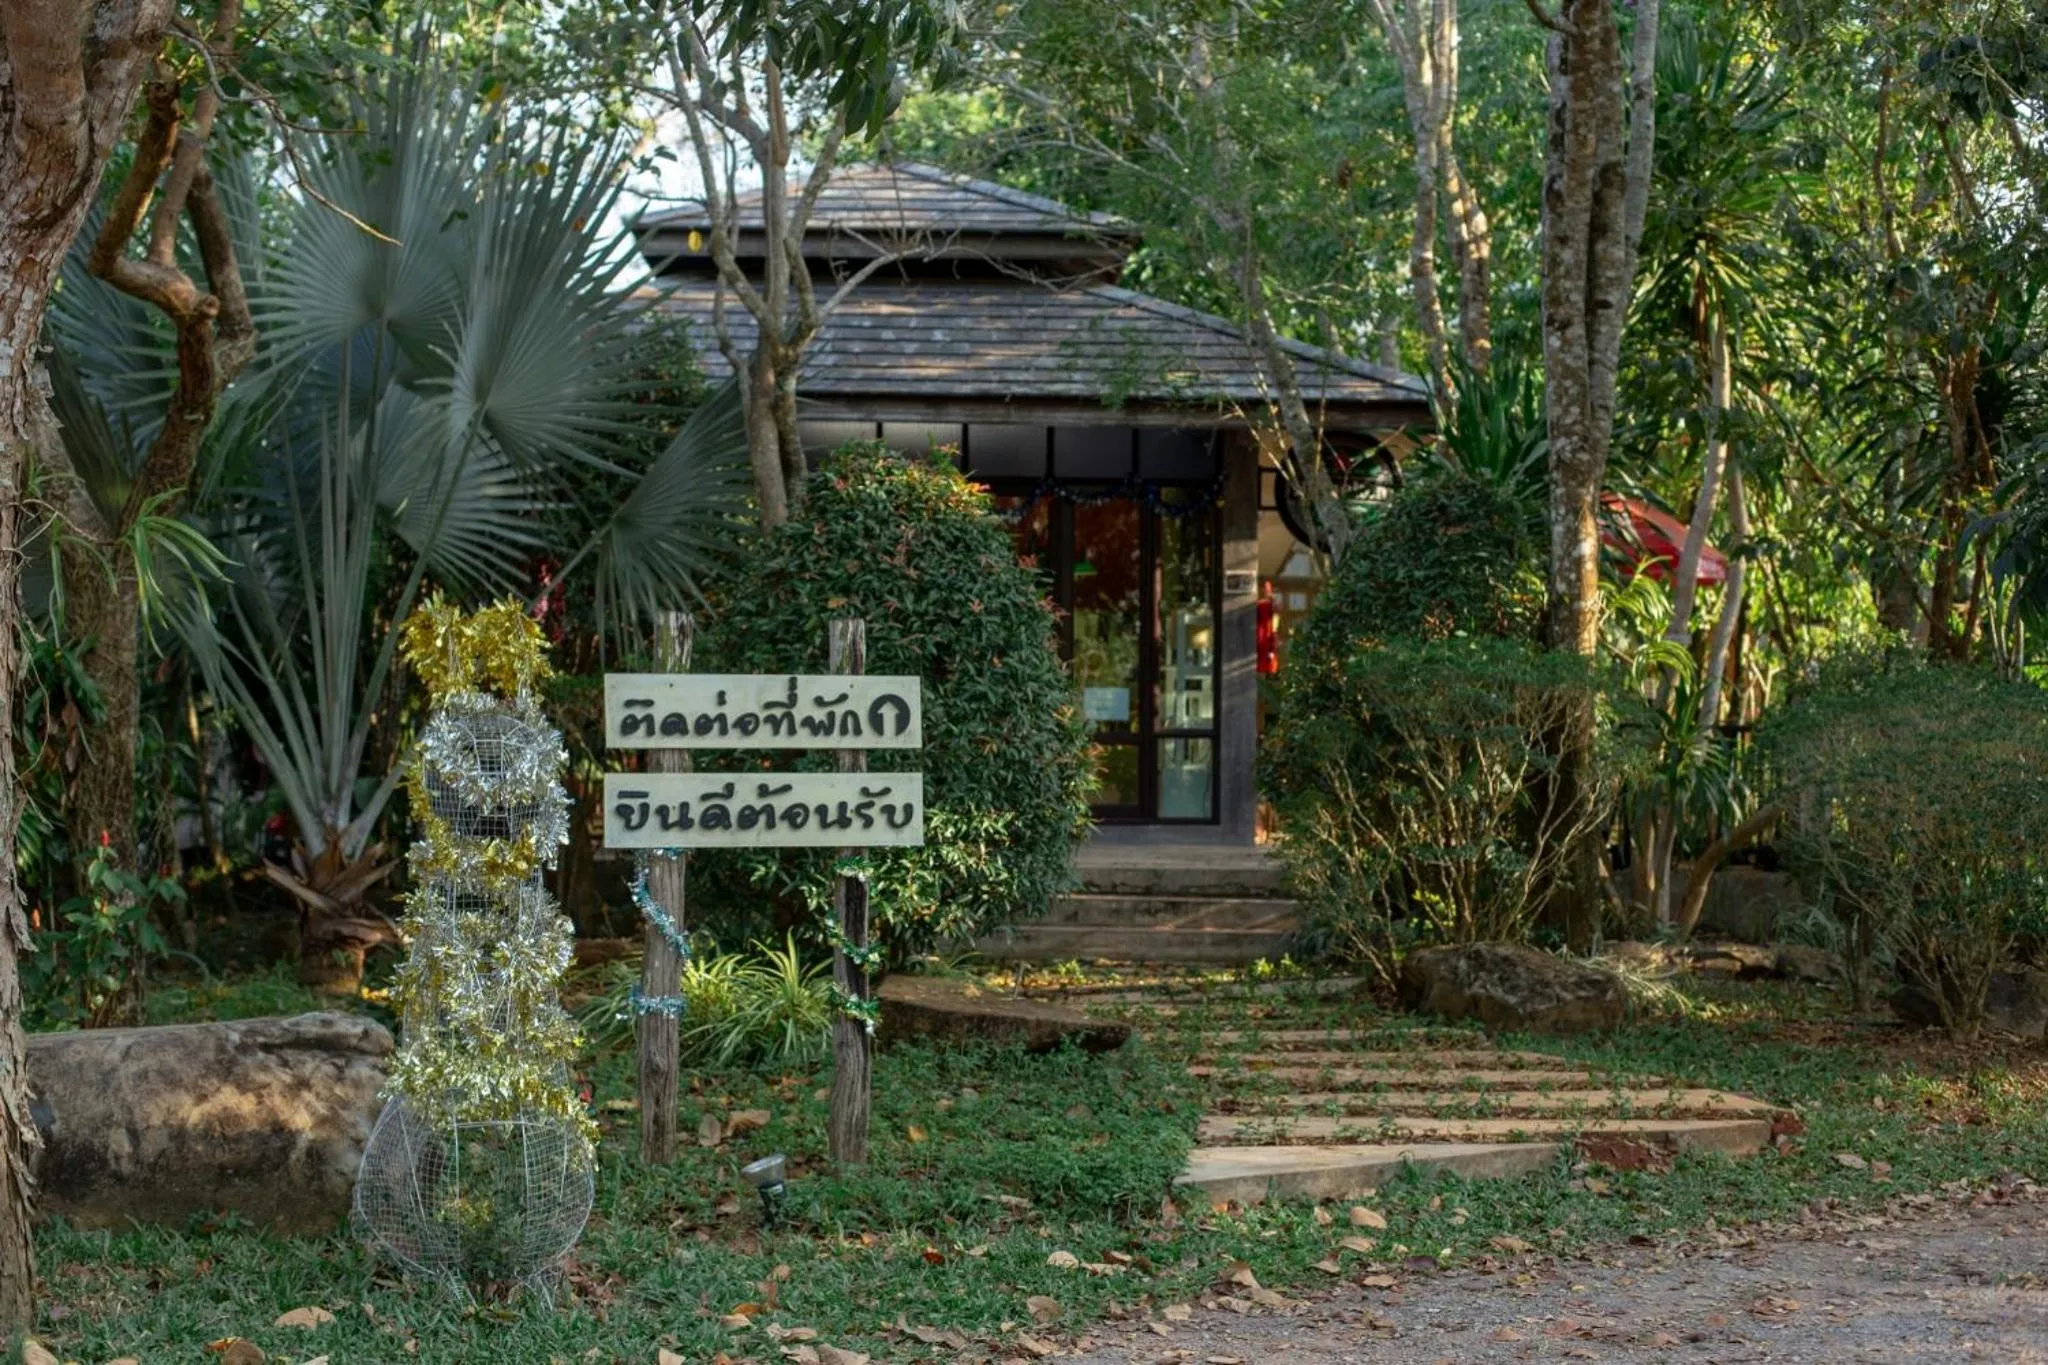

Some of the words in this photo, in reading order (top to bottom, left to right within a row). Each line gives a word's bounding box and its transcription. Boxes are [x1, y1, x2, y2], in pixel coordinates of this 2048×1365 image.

[619, 677, 863, 738] ติดต่อที่พัก
[614, 782, 915, 832] ยินดีต้อนรับ
